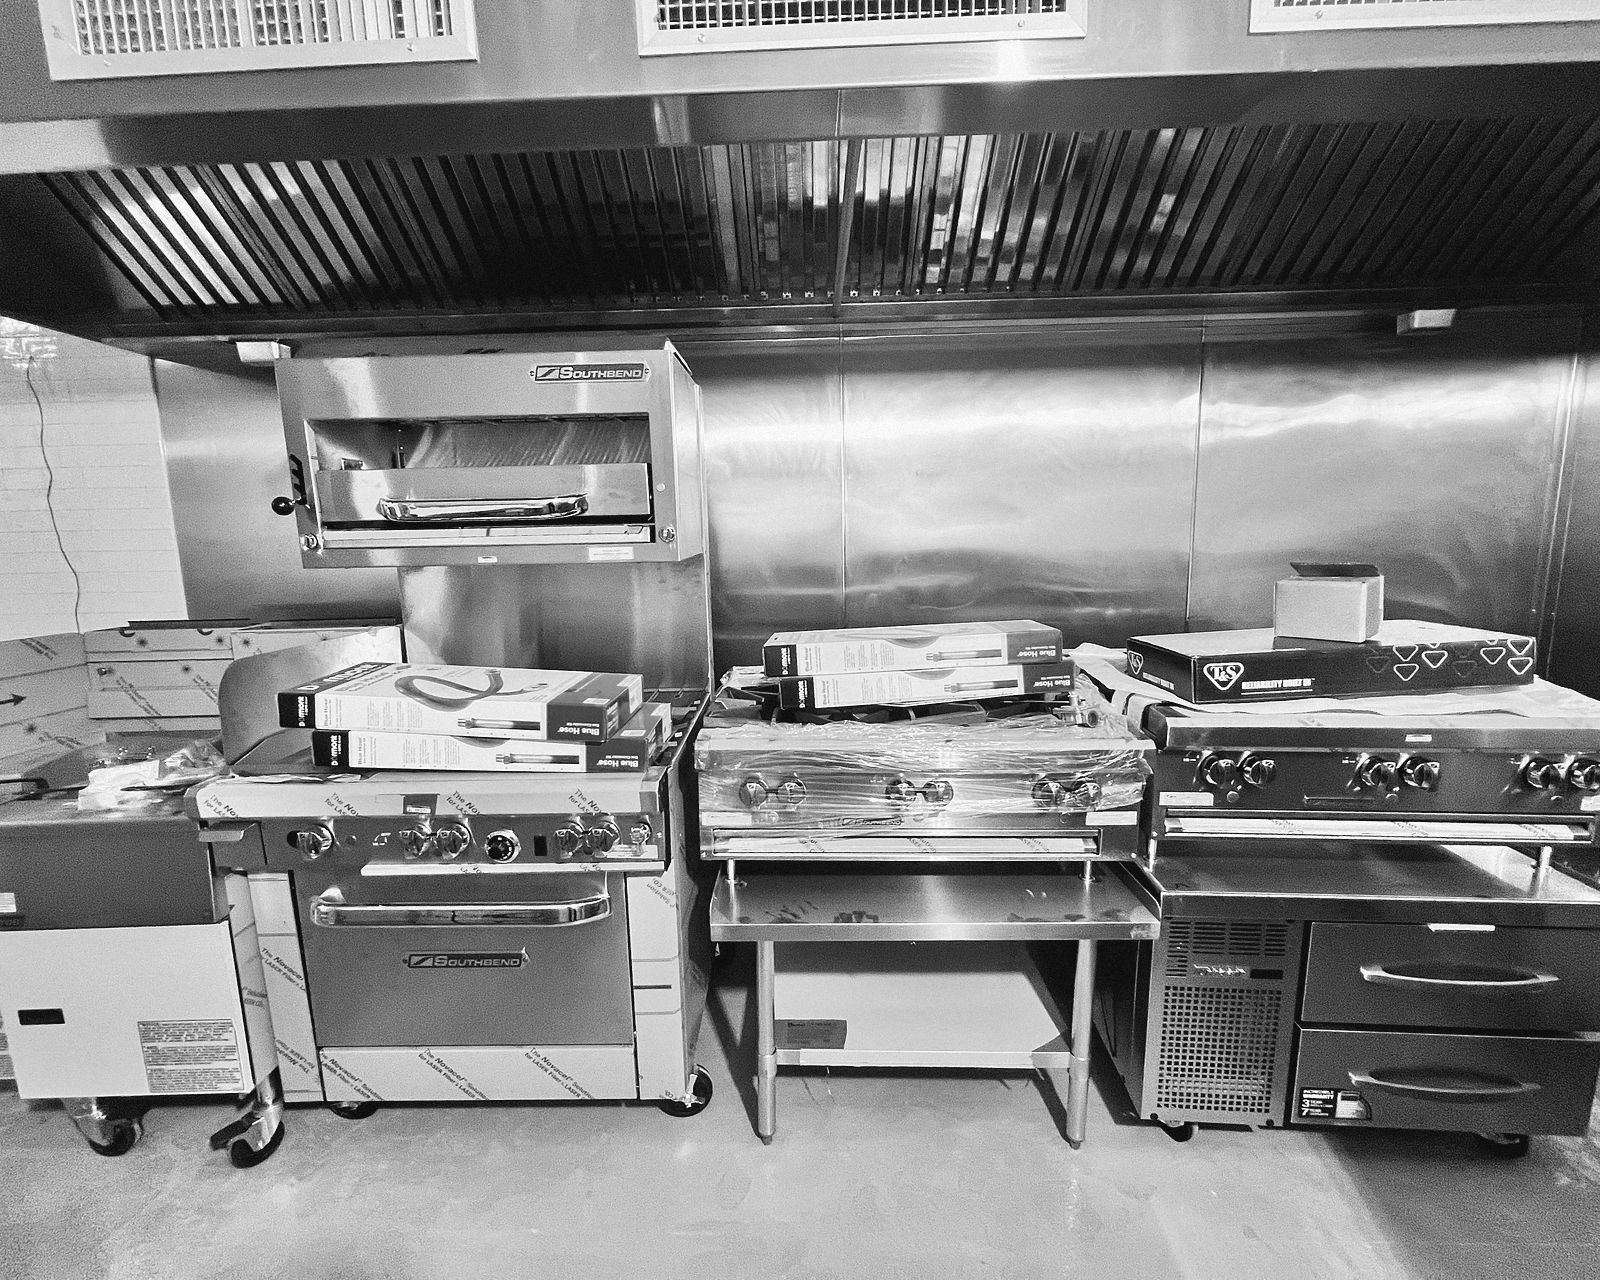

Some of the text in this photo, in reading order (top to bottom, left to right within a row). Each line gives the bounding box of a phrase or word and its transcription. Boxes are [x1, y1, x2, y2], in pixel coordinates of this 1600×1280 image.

[1211, 665, 1237, 681] T&S
[581, 726, 600, 736] Blue
[620, 760, 639, 768] Blue
[331, 793, 344, 804] The
[453, 791, 465, 802] The
[569, 795, 578, 804] for
[575, 789, 587, 800] The
[204, 800, 213, 808] for
[211, 795, 223, 805] The
[447, 797, 456, 805] for
[262, 947, 273, 957] The
[434, 956, 520, 966] SOUTHBEND
[424, 1049, 435, 1059] The
[435, 1057, 464, 1081] Novacel
[530, 1047, 541, 1057] The
[541, 1056, 570, 1080] Novacel
[426, 1060, 442, 1073] LASER
[459, 1085, 475, 1098] LASER
[533, 1059, 548, 1072] LASER
[565, 1084, 580, 1097] LASER
[1302, 1099, 1309, 1107] 3
[1302, 1108, 1309, 1116] 7
